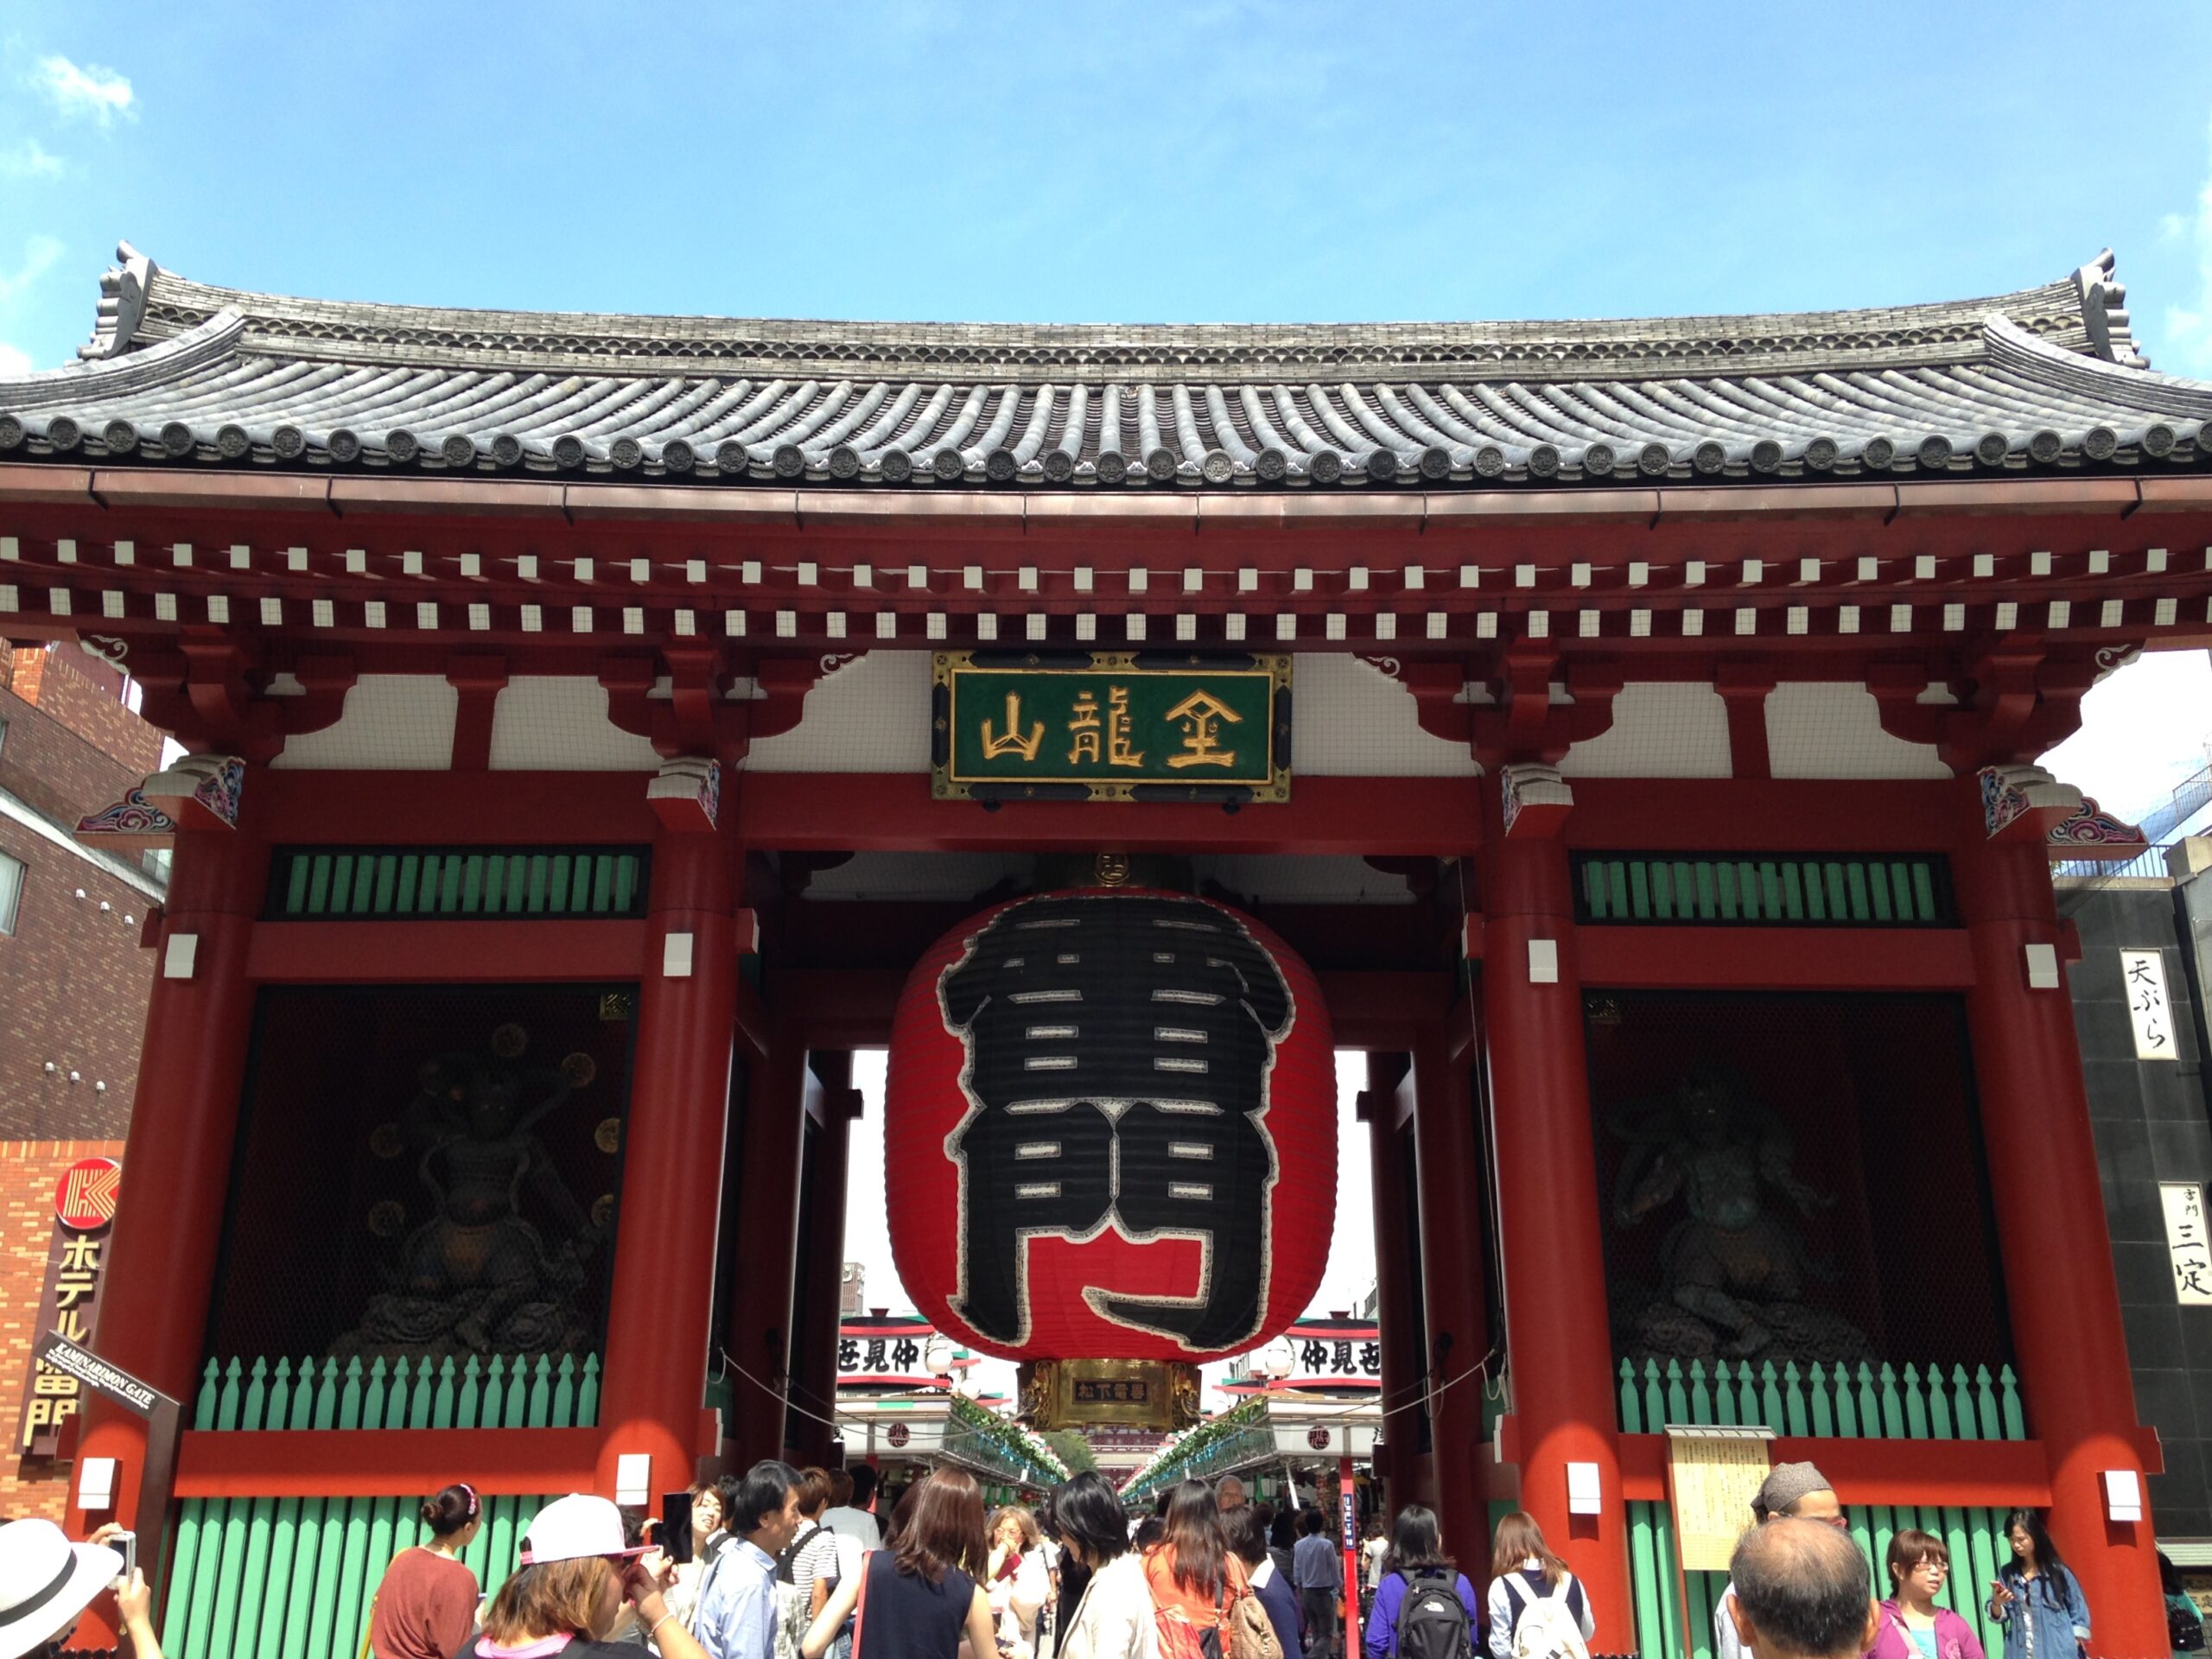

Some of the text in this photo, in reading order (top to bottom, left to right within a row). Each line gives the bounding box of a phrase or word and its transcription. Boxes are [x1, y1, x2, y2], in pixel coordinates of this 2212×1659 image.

[2127, 960, 2165, 1048] 天ぷら
[937, 894, 1296, 1352] 雷門
[54, 1342, 129, 1389] KAMINARIMON
[125, 1382, 156, 1404] GATE
